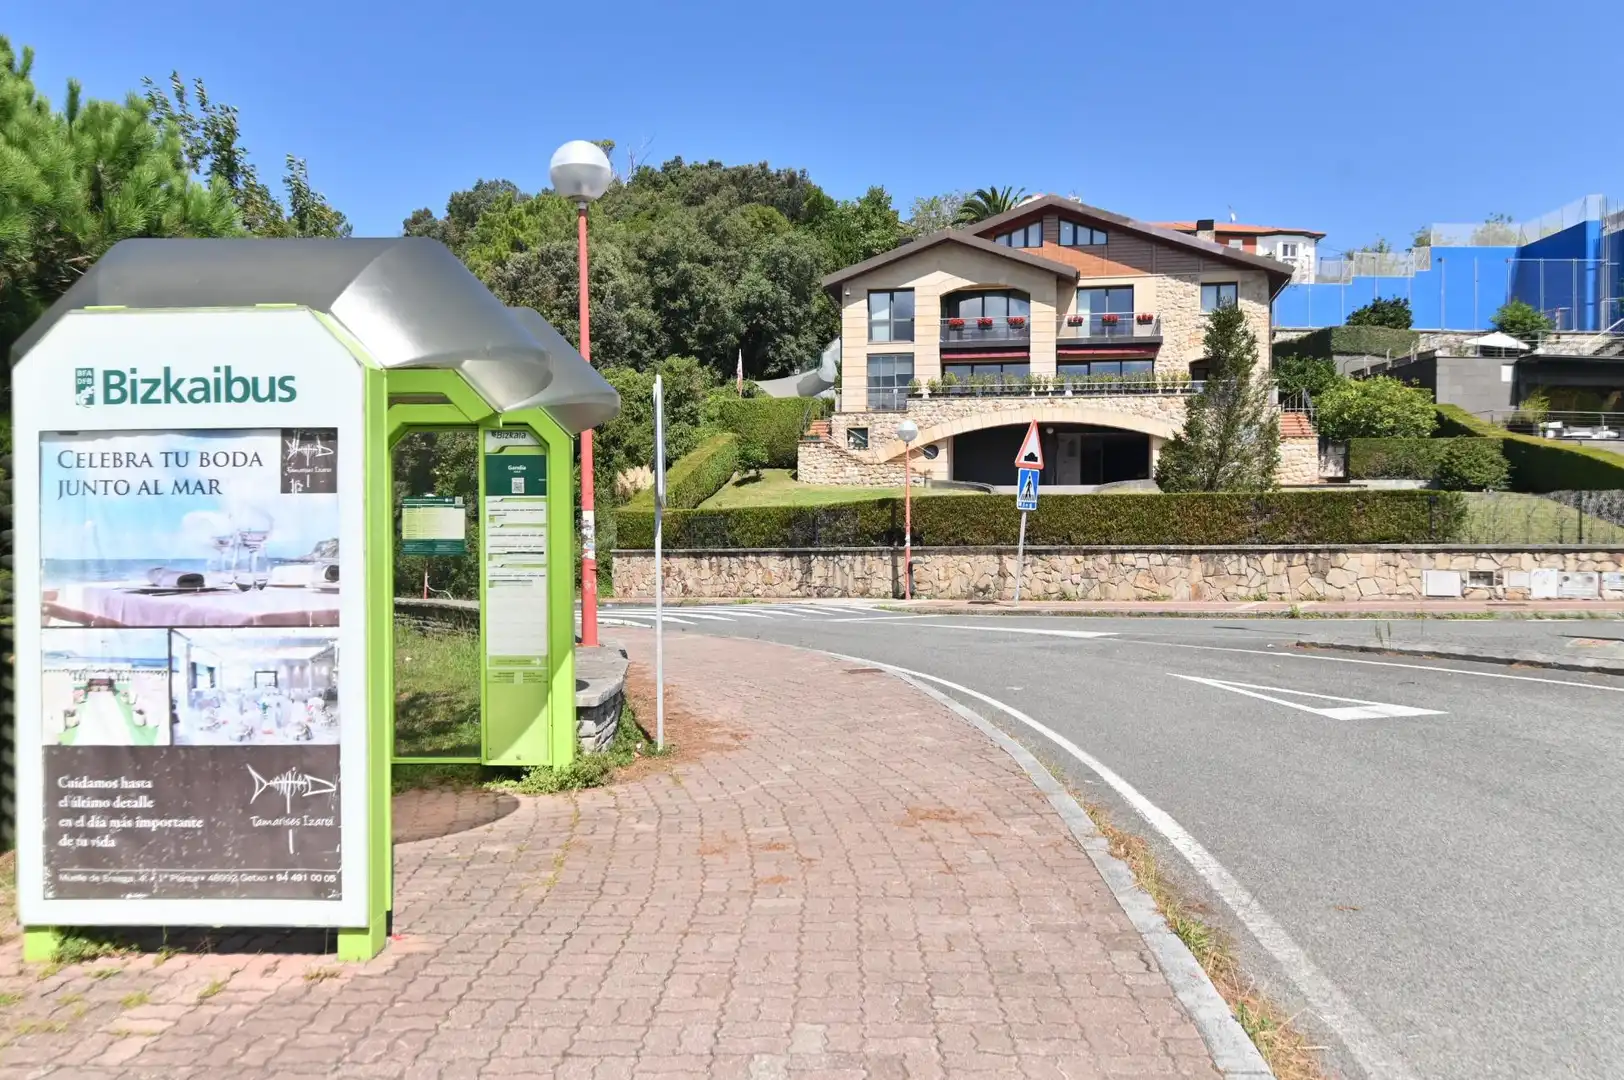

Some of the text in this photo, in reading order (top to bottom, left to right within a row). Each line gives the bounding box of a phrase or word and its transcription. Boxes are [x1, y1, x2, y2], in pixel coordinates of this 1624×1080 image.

[103, 365, 297, 405] Bizkaibus
[160, 451, 189, 468] TU
[199, 451, 263, 467] BODA
[57, 479, 223, 500] JUNTO AL MAR
[120, 776, 153, 789] hasta
[58, 795, 70, 808] el
[112, 795, 155, 808] detalle
[58, 818, 73, 828] en
[75, 815, 86, 828] el
[109, 815, 133, 828] más
[58, 834, 117, 847] de tu vida
[310, 874, 323, 882] 00
